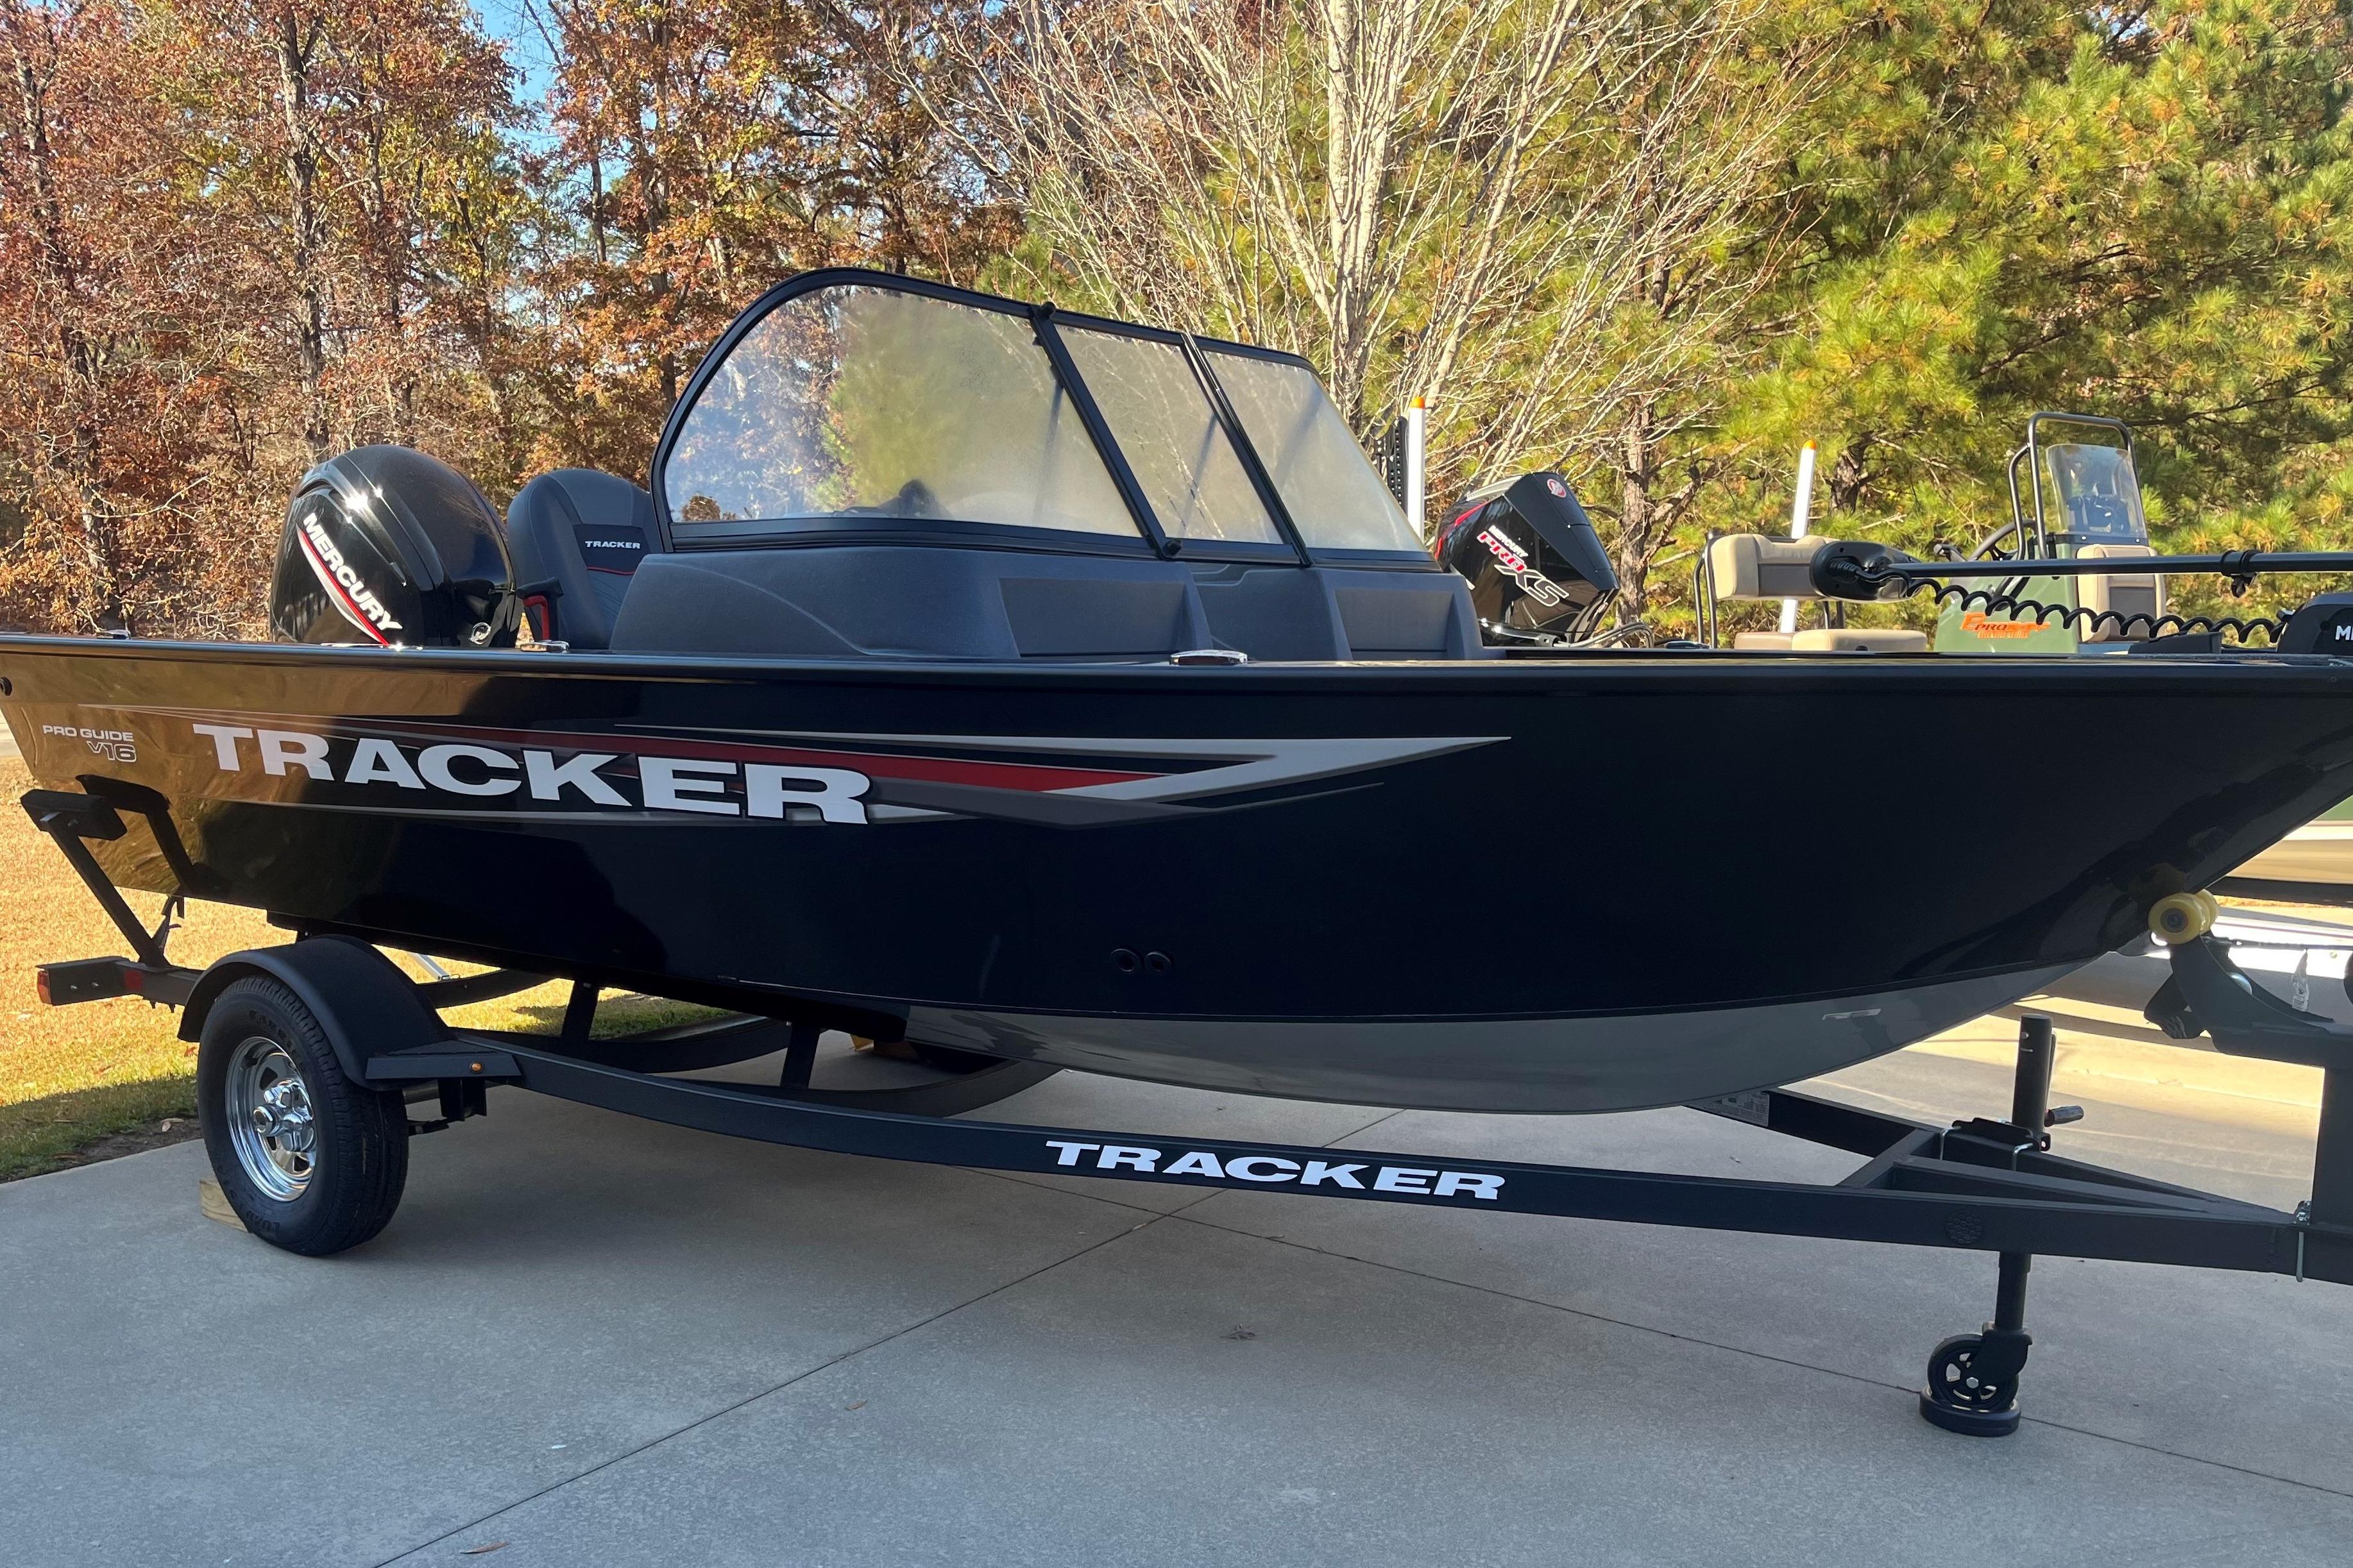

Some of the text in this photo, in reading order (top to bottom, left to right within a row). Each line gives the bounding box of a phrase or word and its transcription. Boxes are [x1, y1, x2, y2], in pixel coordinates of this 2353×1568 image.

[585, 541, 641, 549] TRACKER
[1477, 531, 1527, 573] PRO
[303, 512, 403, 630] MERCURY
[1494, 564, 1570, 607] XS
[42, 725, 134, 742] PRO GUIDE
[86, 741, 137, 763] V16
[192, 723, 872, 825] TRACKER
[1045, 1140, 1506, 1201] TRACKER
